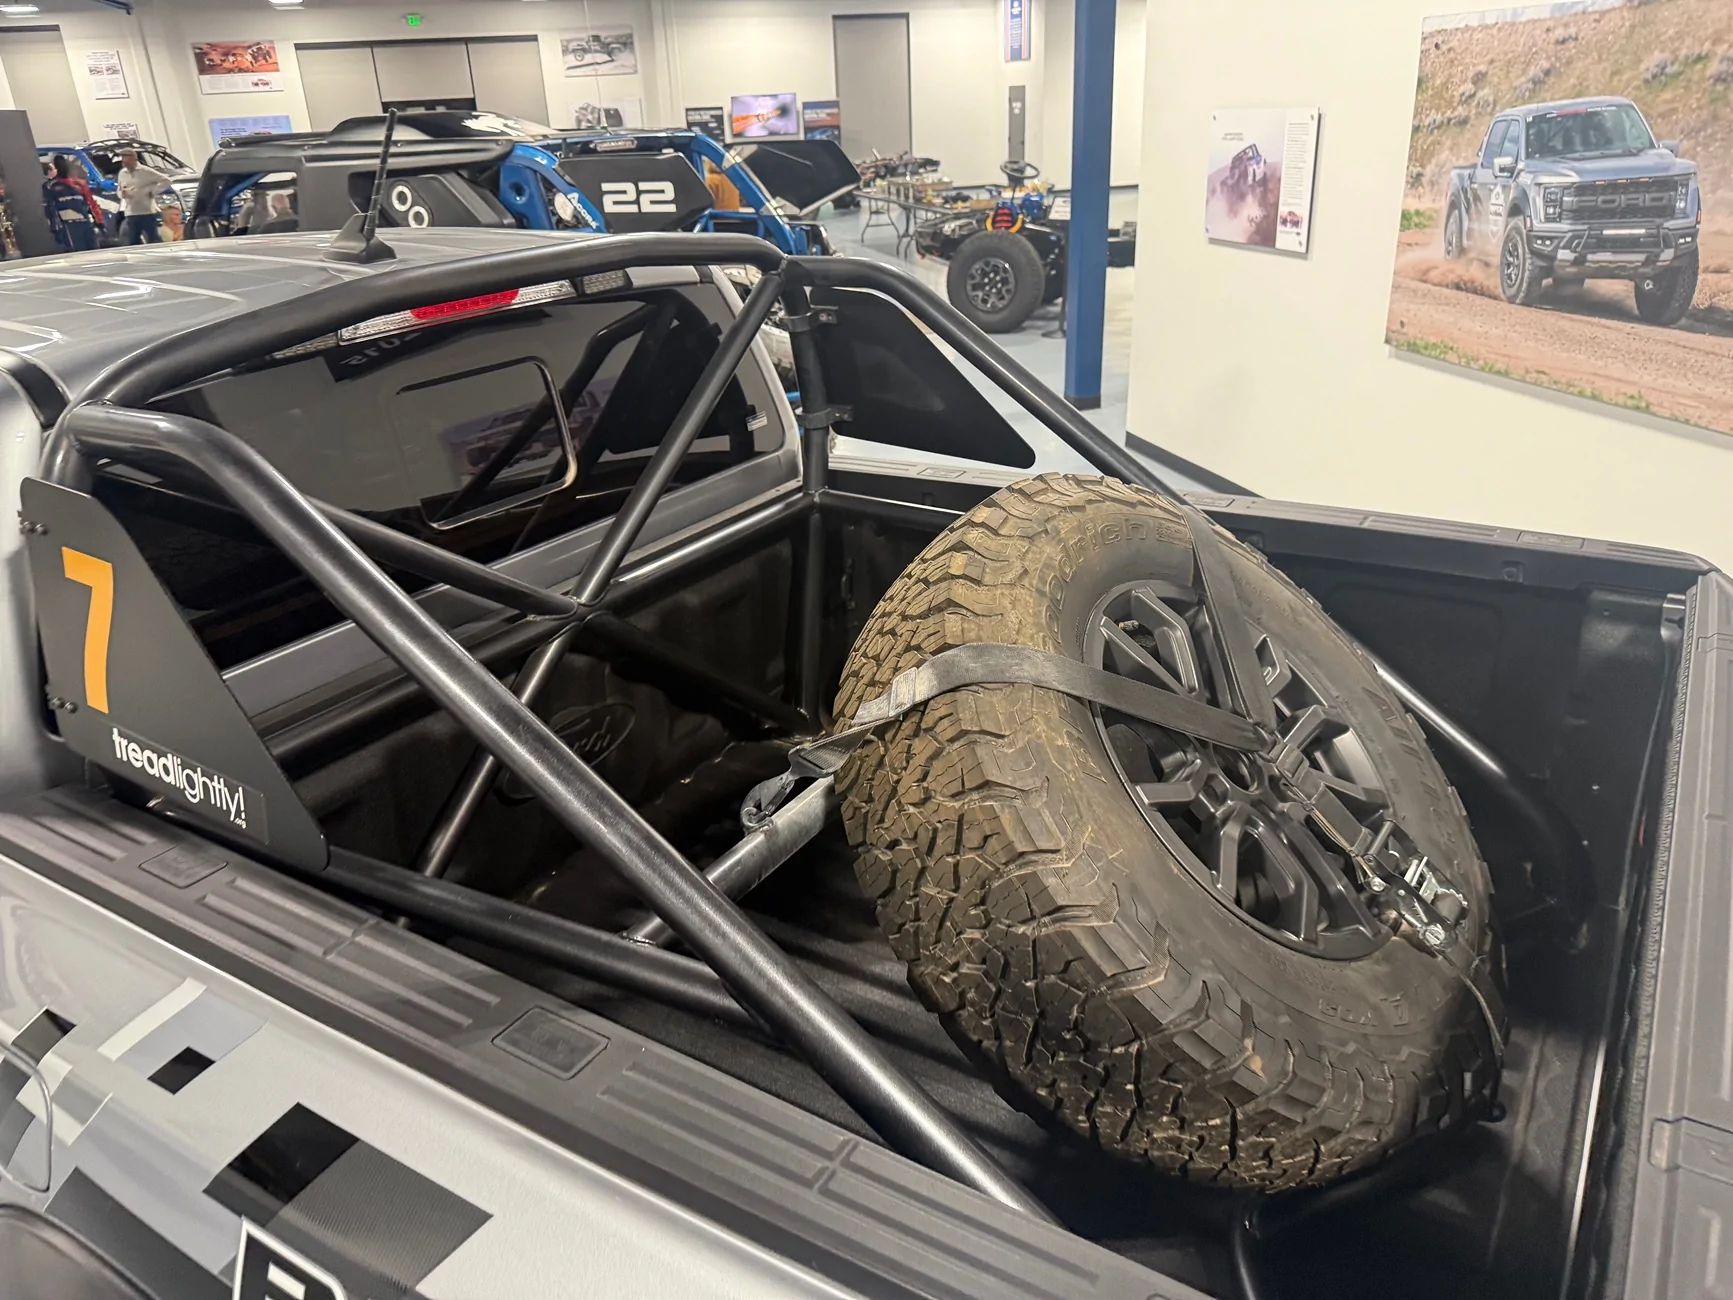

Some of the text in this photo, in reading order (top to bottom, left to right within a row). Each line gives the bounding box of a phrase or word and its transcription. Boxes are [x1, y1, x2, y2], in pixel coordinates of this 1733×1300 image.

[600, 181, 677, 213] 22
[1573, 191, 1668, 209] FORD
[61, 546, 114, 714] 7
[112, 726, 246, 822] treadlightly!
